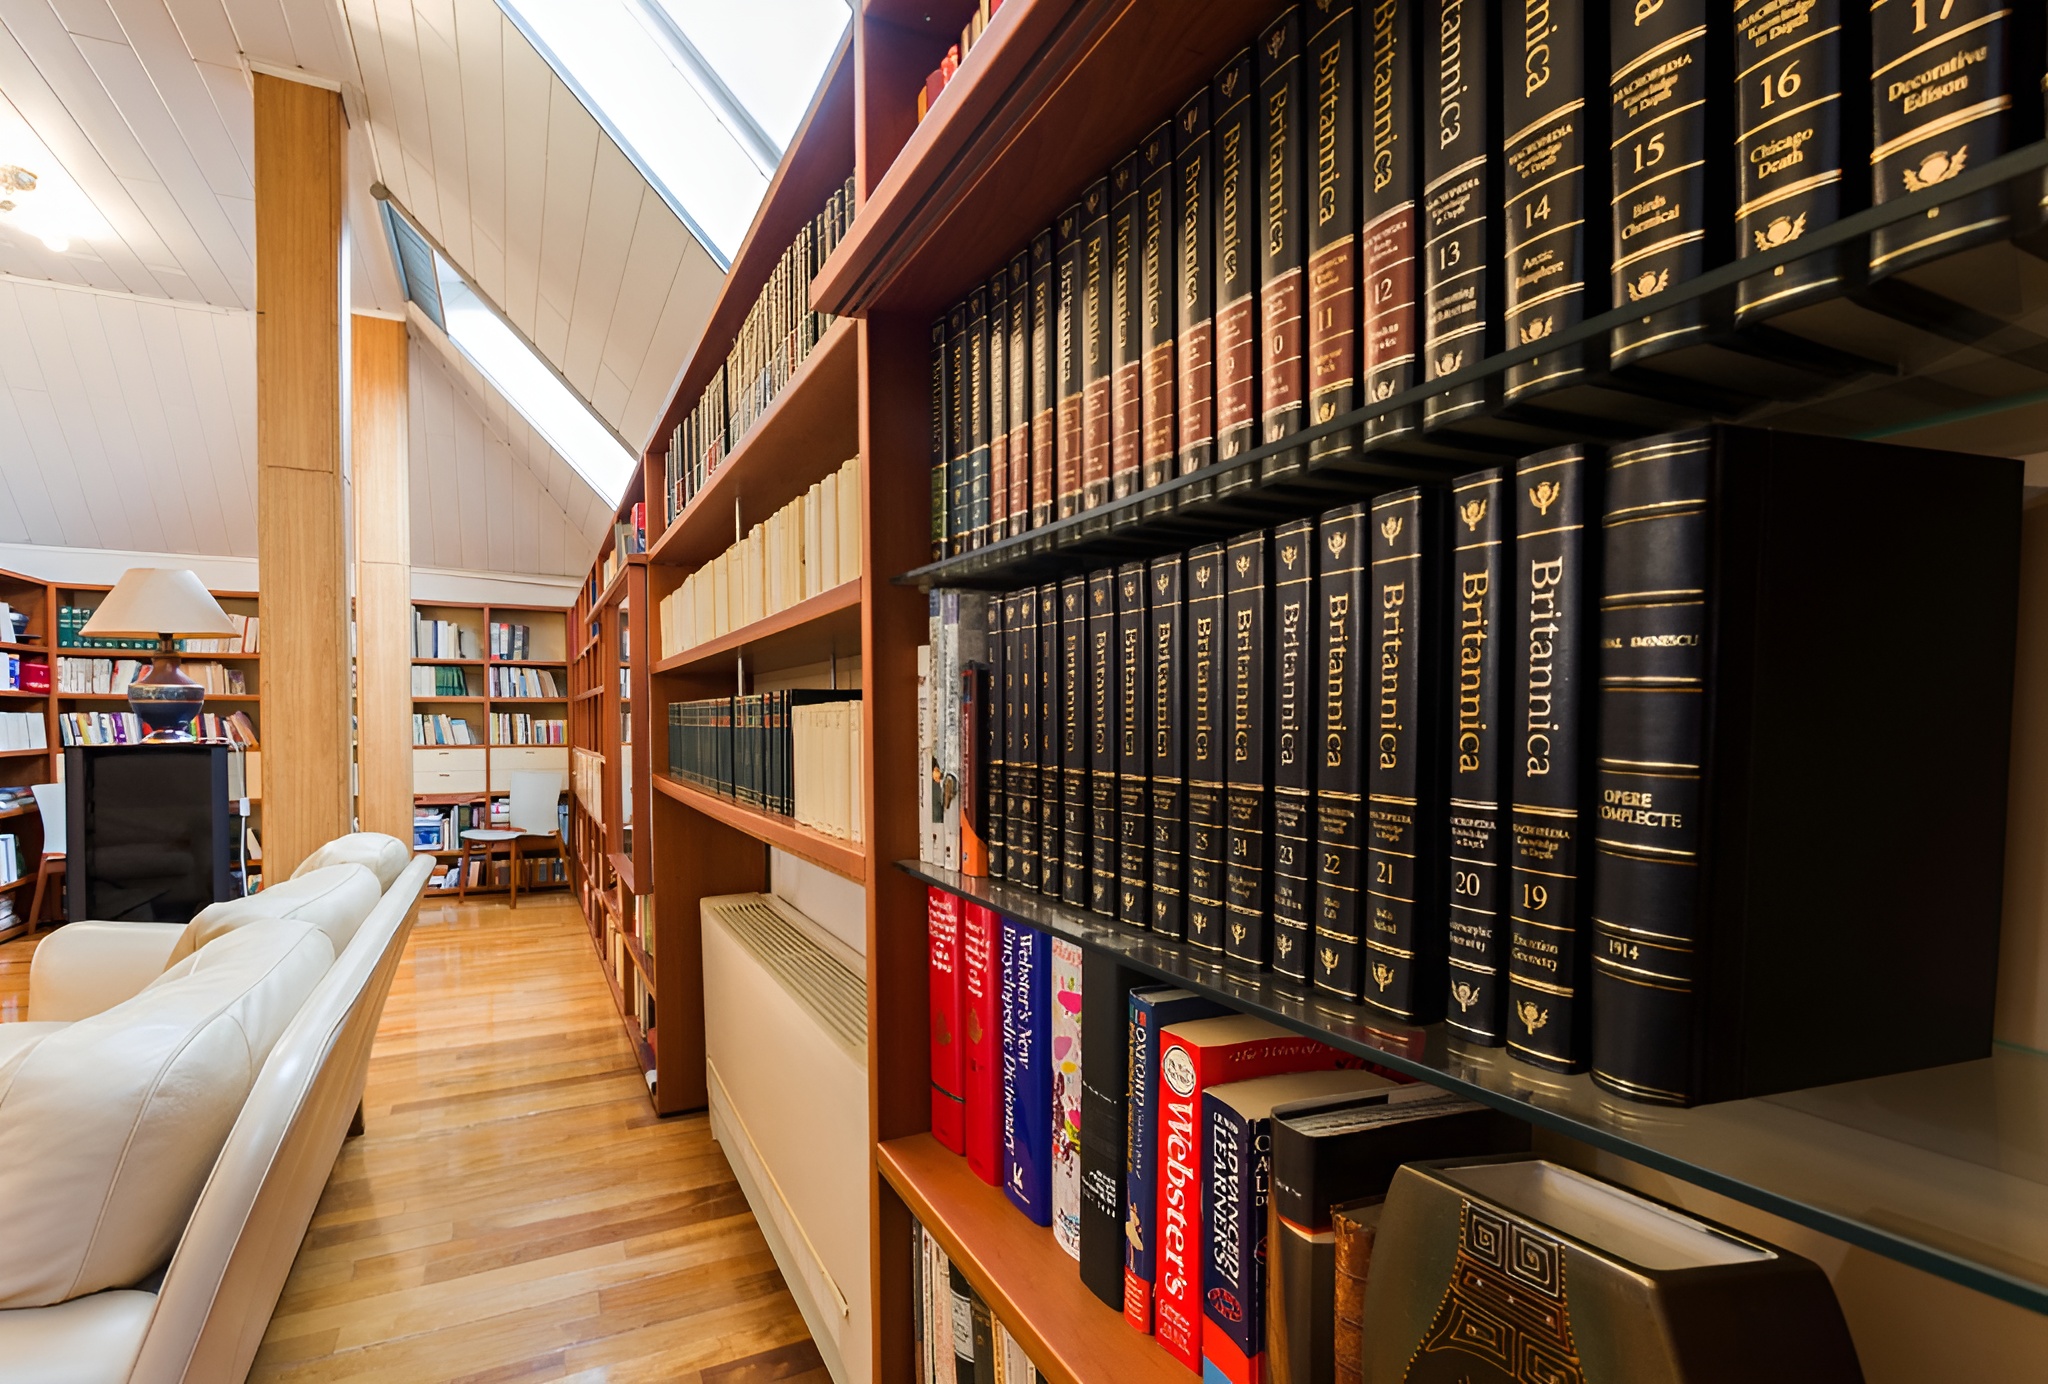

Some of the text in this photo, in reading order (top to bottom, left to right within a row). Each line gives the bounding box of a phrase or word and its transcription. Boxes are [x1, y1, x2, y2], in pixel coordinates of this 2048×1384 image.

[1760, 60, 1801, 109] 16
[1888, 45, 1988, 102] Decorative
[1903, 75, 1969, 114] Edison
[1319, 38, 1340, 227] Britannica
[1633, 132, 1665, 174] 15
[1750, 128, 1813, 163] Chicago
[1269, 82, 1288, 258] Britannica
[1758, 150, 1804, 180] Death
[1223, 121, 1241, 285] Britannica
[1525, 194, 1551, 229] 14
[1621, 203, 1680, 240] Chemical
[1633, 195, 1667, 219] Birds
[1185, 155, 1201, 310] Britannica
[1440, 240, 1461, 271] 13
[1374, 278, 1393, 305] 12
[1196, 617, 1213, 761] Britannica
[1235, 607, 1253, 763] Britannica
[1281, 602, 1301, 767] Britannica
[1327, 593, 1349, 767] Britannica
[1380, 581, 1405, 771] Britannica
[1459, 569, 1489, 774] Britannica
[1527, 556, 1563, 777] Britannica
[1598, 805, 1682, 829] OMPLECTE
[1604, 789, 1653, 808] OPERE
[1376, 861, 1393, 885] 21
[1455, 871, 1480, 897] 20
[1523, 884, 1548, 911] 19
[1609, 939, 1640, 961] 1914
[1018, 933, 1033, 1022] Webster's
[1165, 1102, 1194, 1301] Webster's
